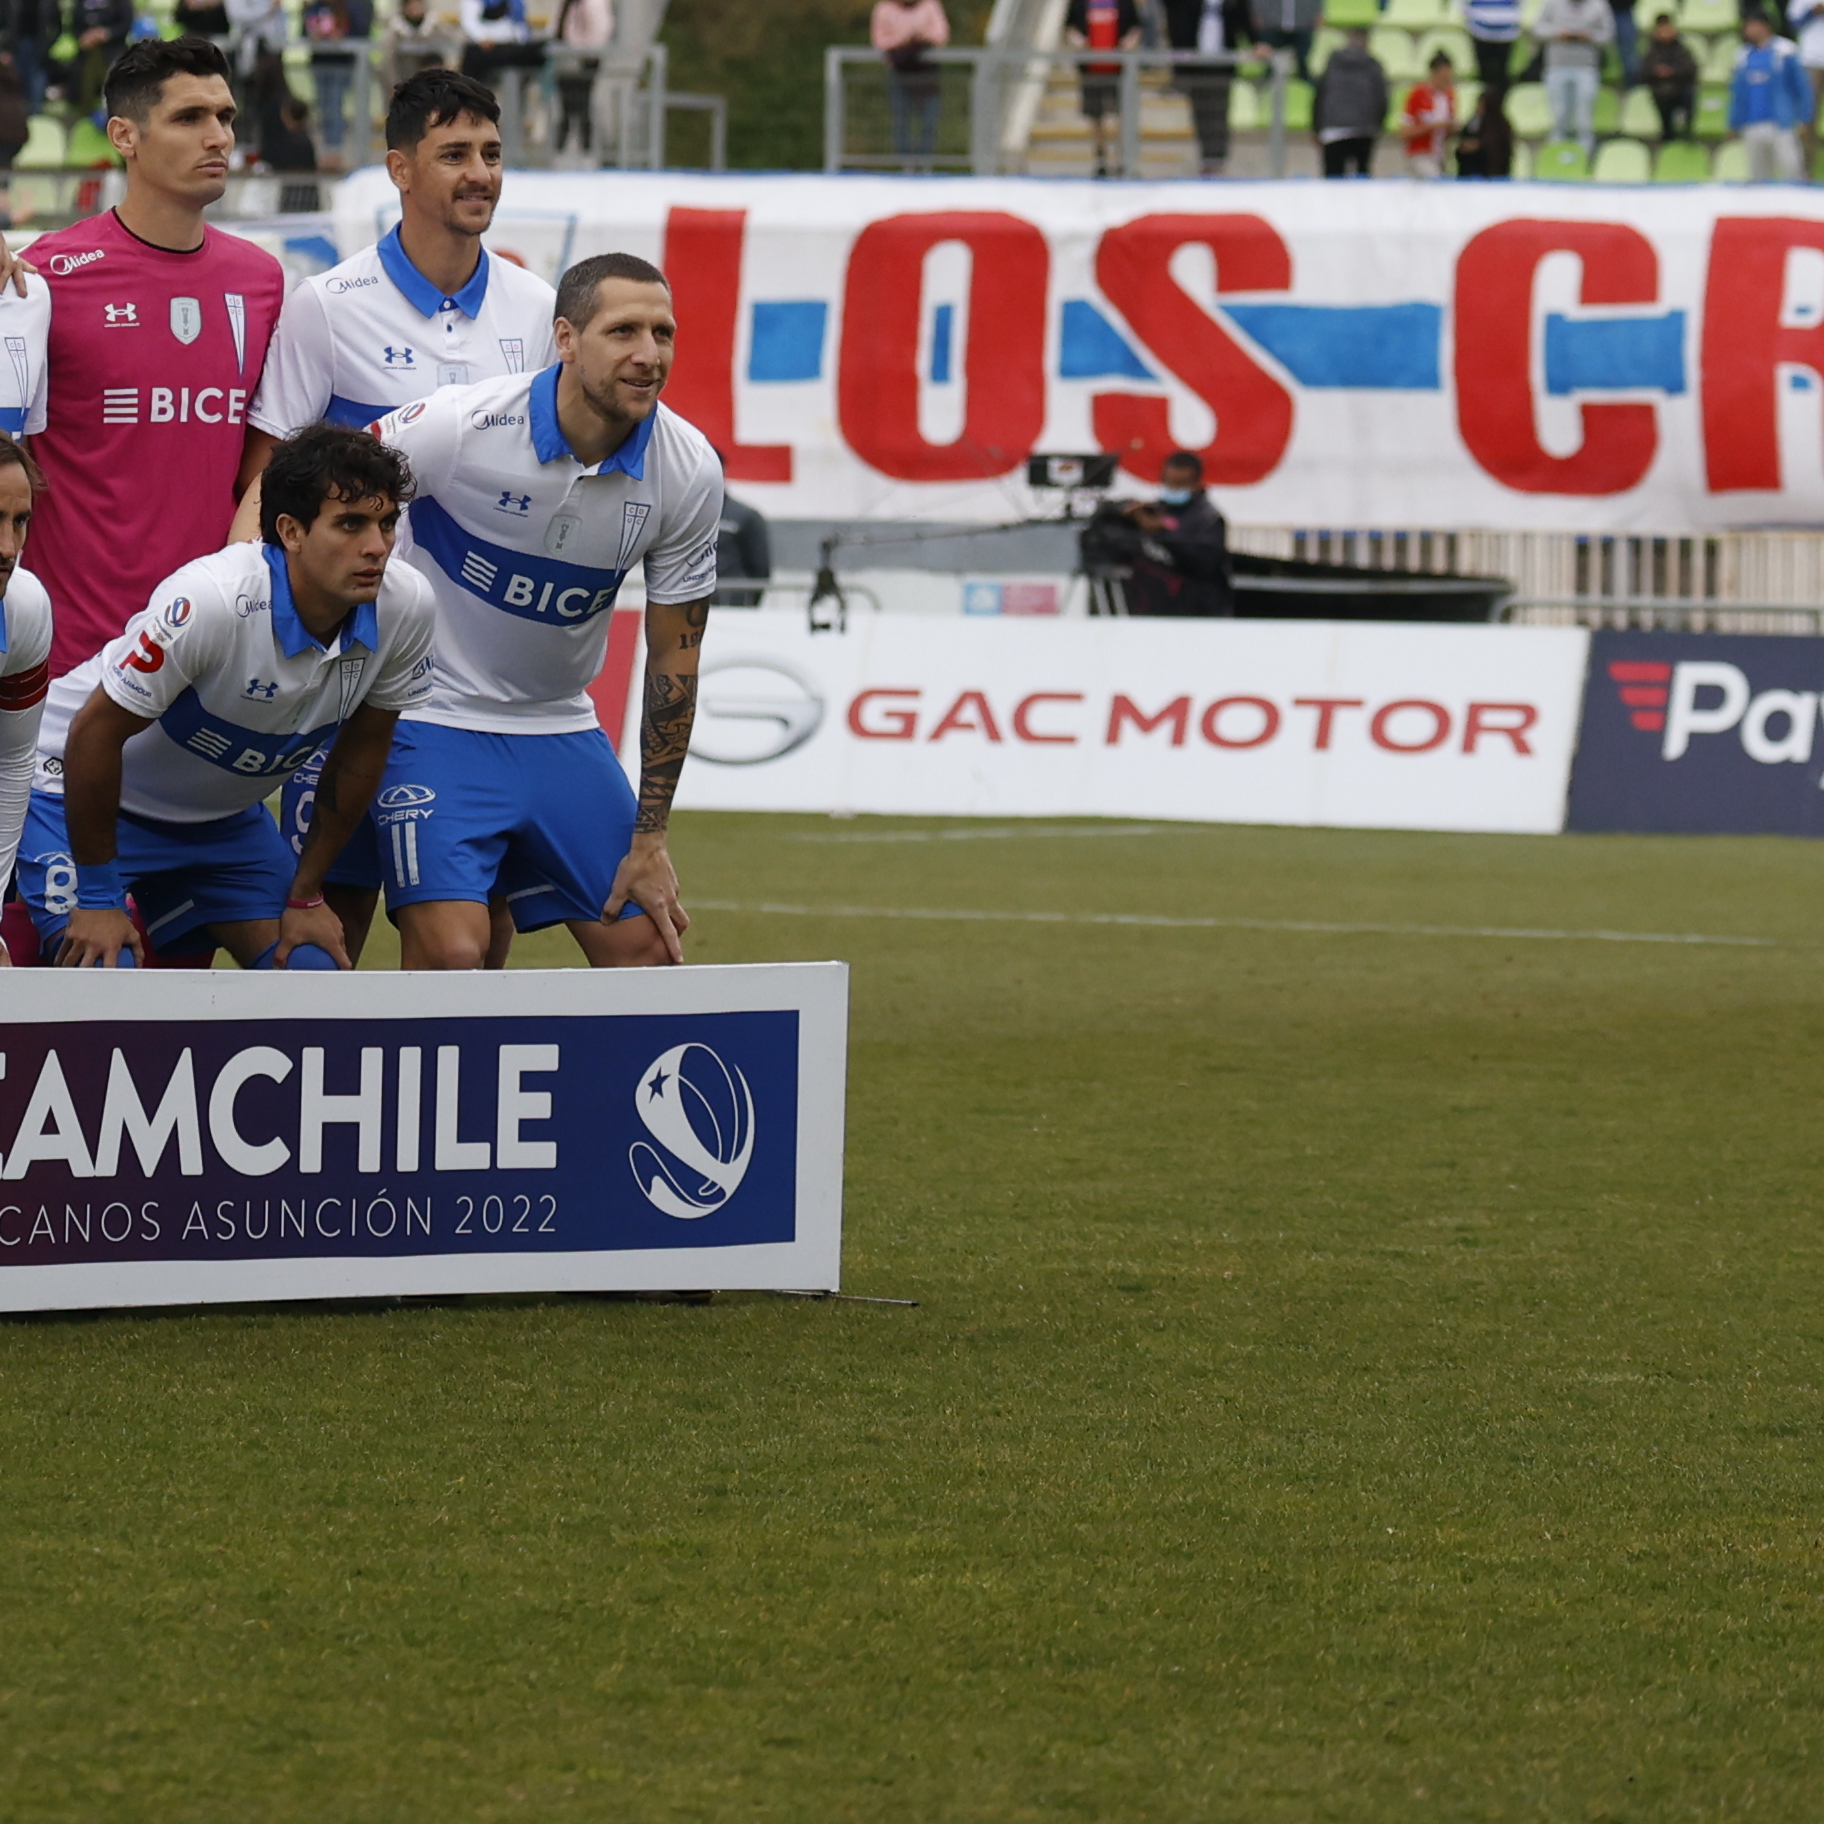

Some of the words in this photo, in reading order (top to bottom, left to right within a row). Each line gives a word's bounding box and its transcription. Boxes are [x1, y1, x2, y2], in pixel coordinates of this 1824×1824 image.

[50, 249, 105, 275] Midea
[326, 275, 378, 294] Midea
[663, 205, 1294, 486] LOS
[150, 387, 247, 424] BICE
[471, 409, 524, 430] Midea
[503, 573, 616, 618] BICE
[847, 688, 1085, 745] GAC
[1104, 694, 1540, 757] MOTOR
[378, 809, 435, 825] CHERY
[391, 821, 420, 888] 11
[182, 1188, 433, 1243] ASUNCIÓN
[454, 1194, 559, 1236] 2022
